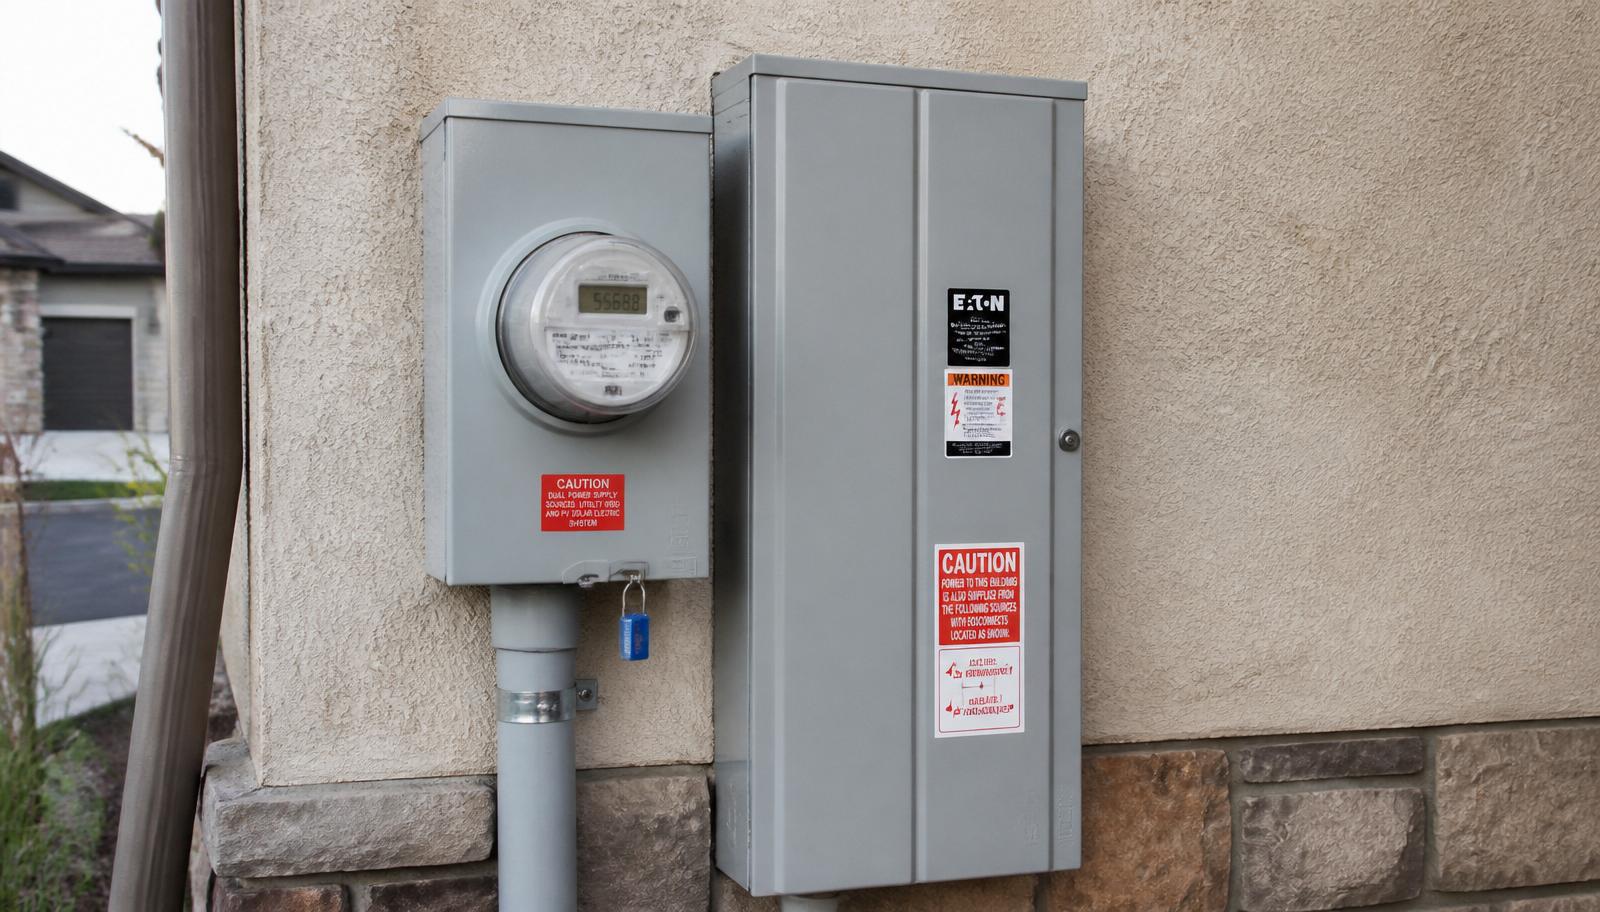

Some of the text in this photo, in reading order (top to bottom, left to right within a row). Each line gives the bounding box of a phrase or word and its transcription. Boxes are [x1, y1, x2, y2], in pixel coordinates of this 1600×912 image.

[953, 373, 1005, 386] WARNING
[556, 478, 610, 489] CAUTION
[942, 551, 1016, 574] CAUTION
[978, 629, 986, 639] AS
